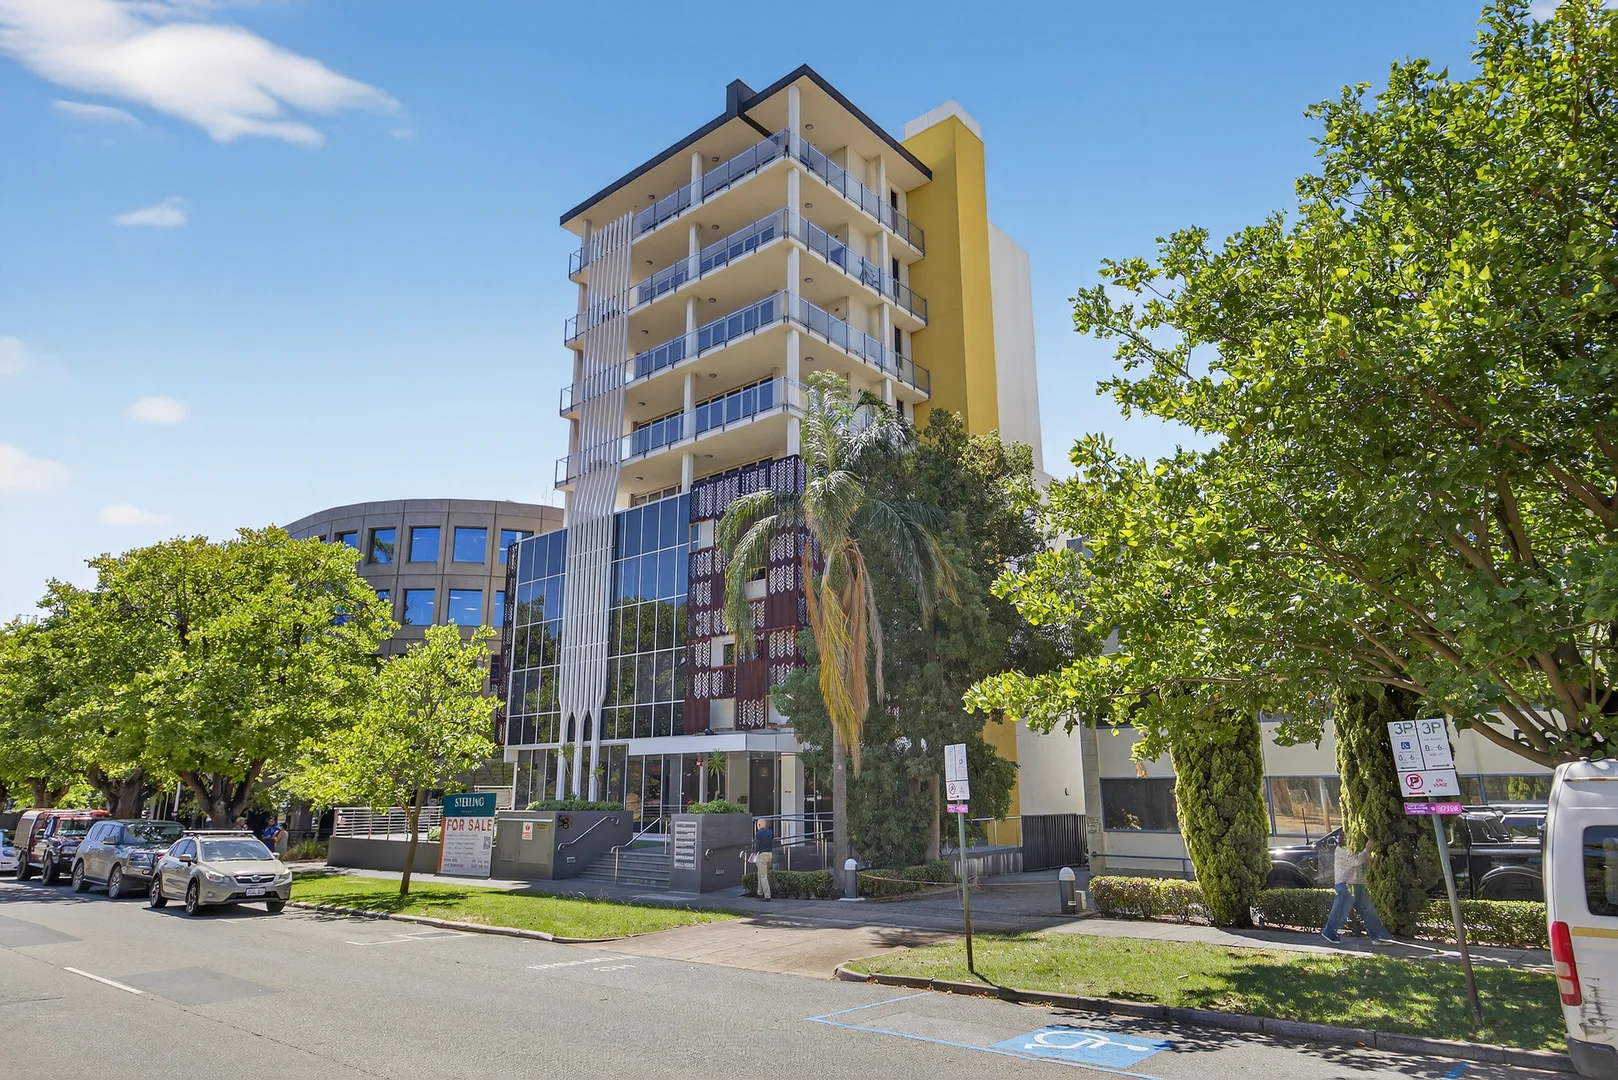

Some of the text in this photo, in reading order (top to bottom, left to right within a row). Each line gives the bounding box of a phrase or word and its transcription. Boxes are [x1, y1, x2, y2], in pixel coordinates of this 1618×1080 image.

[1394, 722, 1413, 734] 3P
[1422, 722, 1441, 734] 3P
[446, 818, 492, 831] FOR SALE
[558, 815, 569, 829] 58
